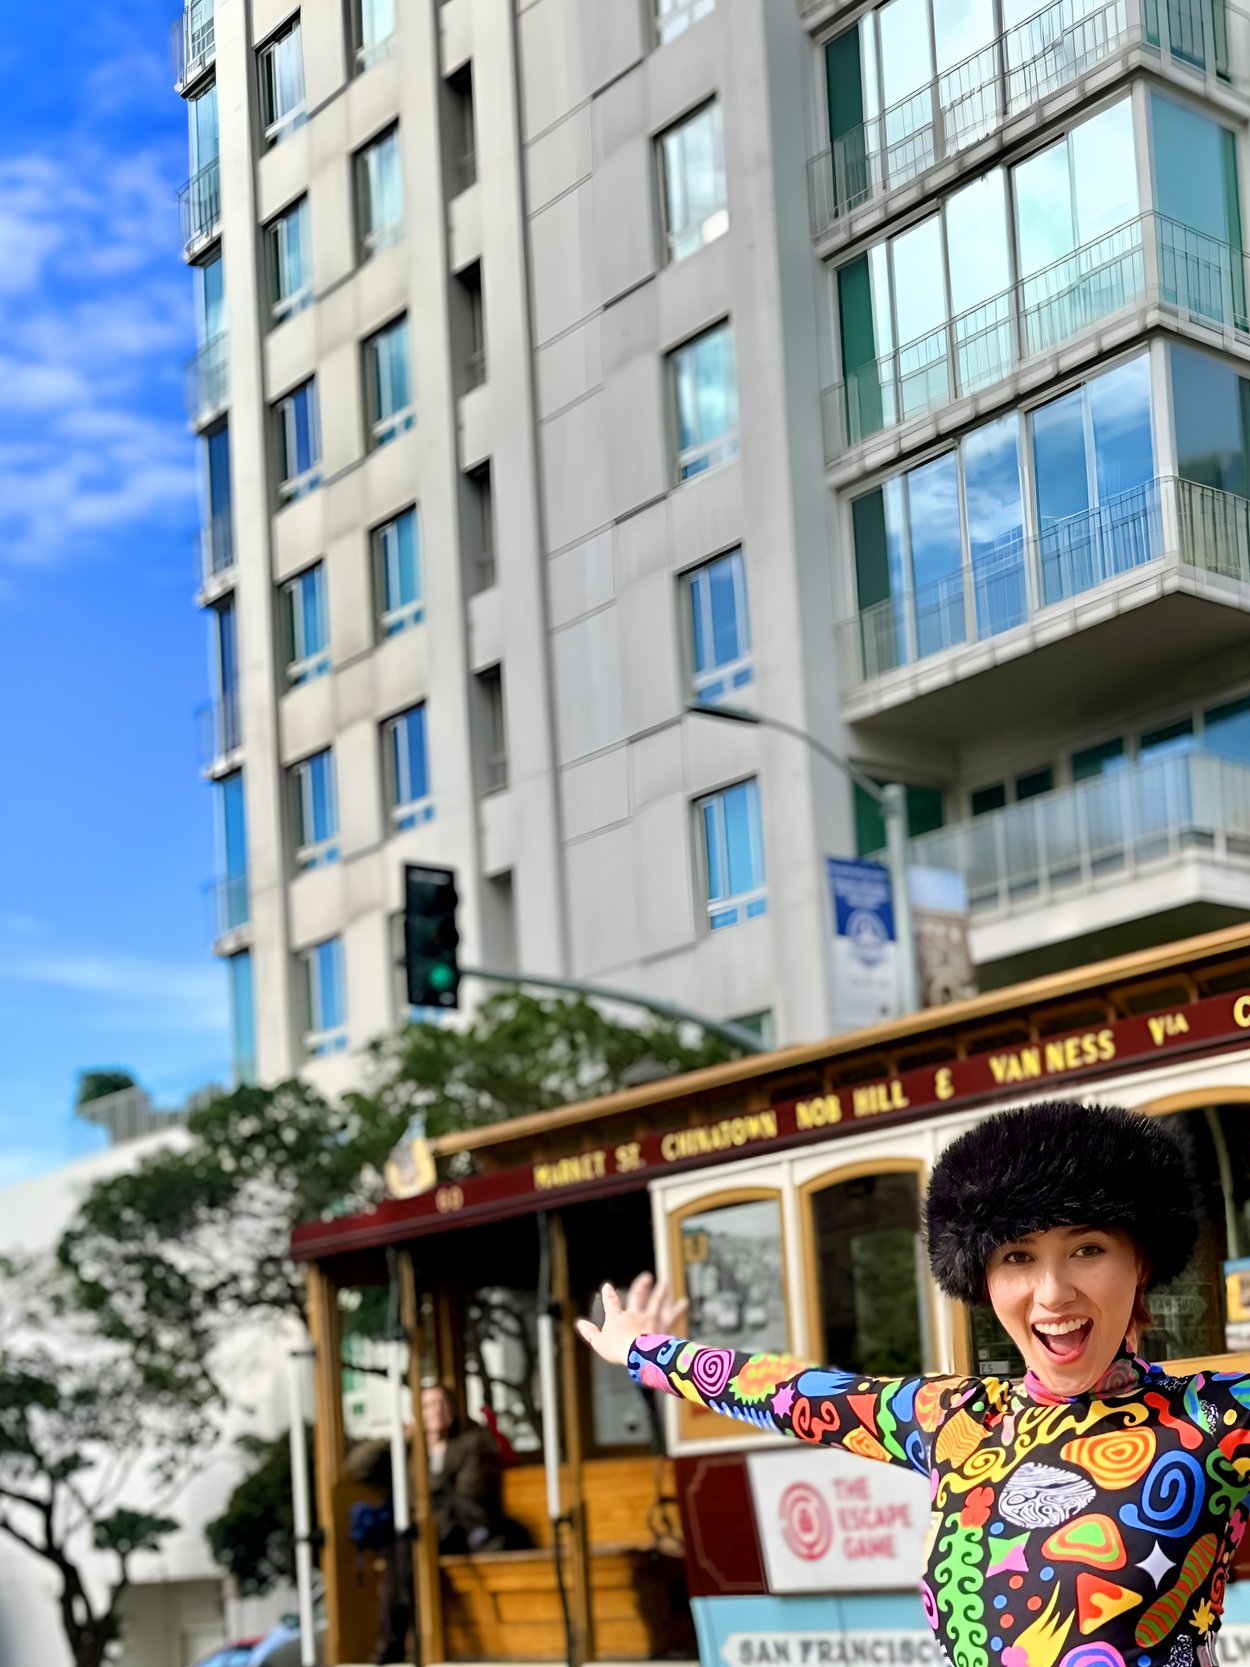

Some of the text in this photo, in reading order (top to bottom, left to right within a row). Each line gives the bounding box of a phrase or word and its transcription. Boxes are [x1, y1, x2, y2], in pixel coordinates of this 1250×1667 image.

[532, 1151, 607, 1190] MARKET
[661, 1111, 777, 1162] CHINATOWN
[796, 1094, 842, 1130] NOB
[853, 1080, 909, 1118] HILL
[988, 1047, 1041, 1084] VAN
[1045, 1029, 1116, 1073] NESS
[831, 1475, 870, 1501] THE
[837, 1502, 912, 1534] ESCAPE
[841, 1534, 898, 1562] GAME
[738, 1638, 790, 1666] SAN
